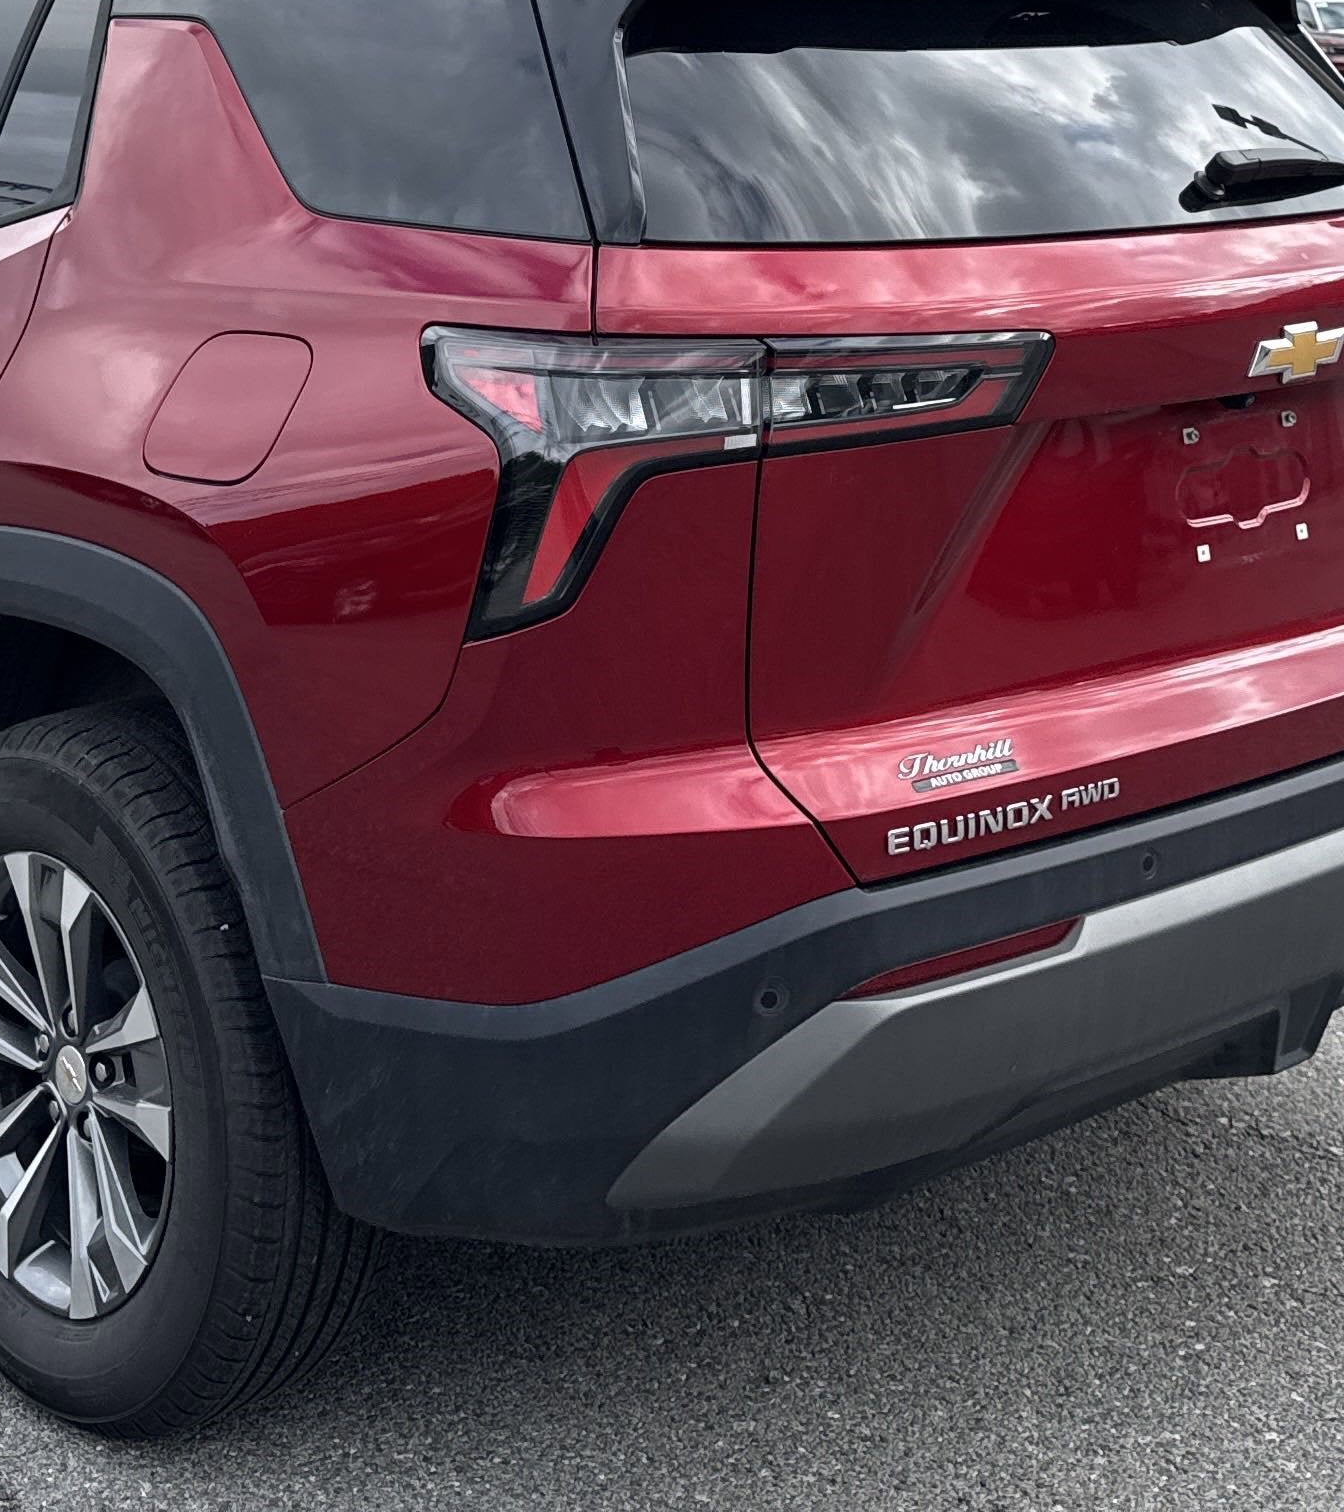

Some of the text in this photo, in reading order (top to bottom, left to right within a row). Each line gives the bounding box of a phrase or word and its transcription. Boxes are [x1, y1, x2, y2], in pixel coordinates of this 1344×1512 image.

[897, 738, 1014, 780] Thornhill
[929, 763, 1003, 788] AUTO GROUP
[887, 777, 1120, 855] EQUINOX AWD
